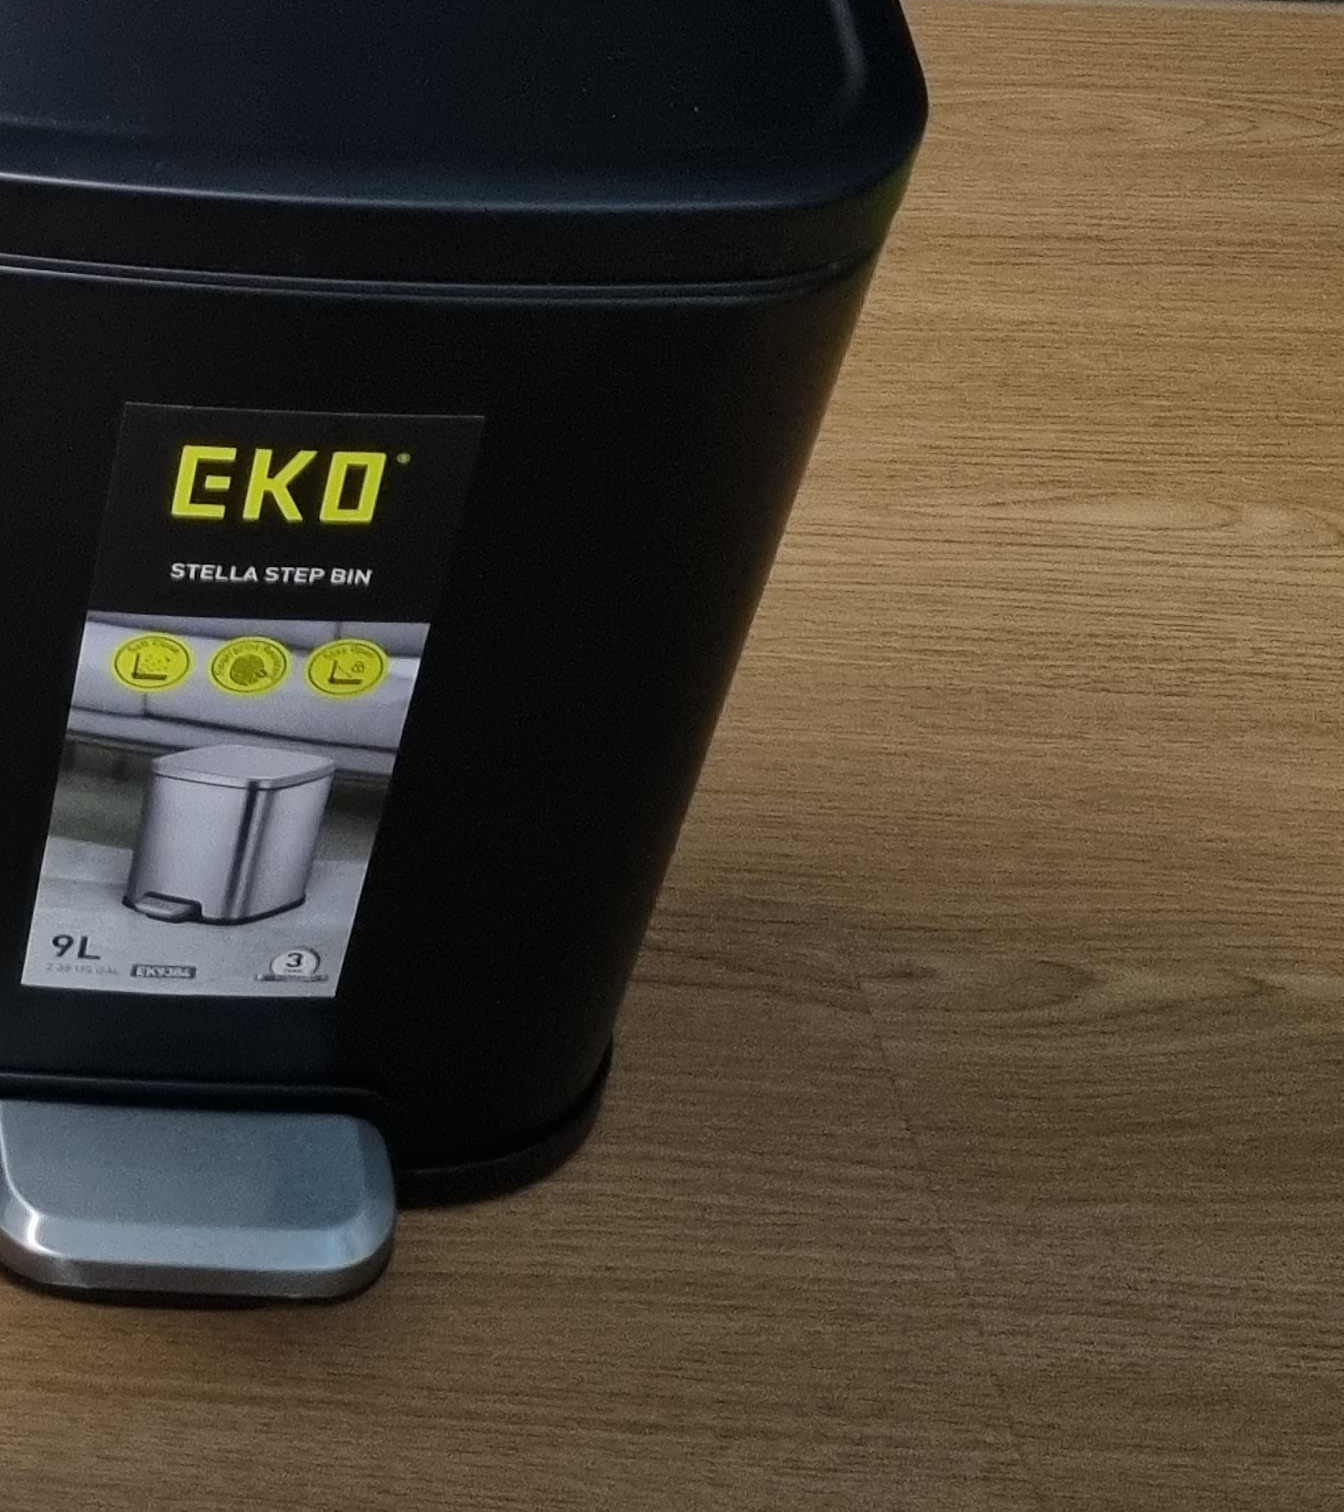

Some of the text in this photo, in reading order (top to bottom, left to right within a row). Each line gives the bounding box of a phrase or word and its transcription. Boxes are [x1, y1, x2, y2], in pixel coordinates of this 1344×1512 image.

[171, 444, 388, 523] EKO
[170, 561, 373, 586] STELLA STEP BIN
[52, 933, 102, 961] 9L
[284, 951, 305, 969] 3
